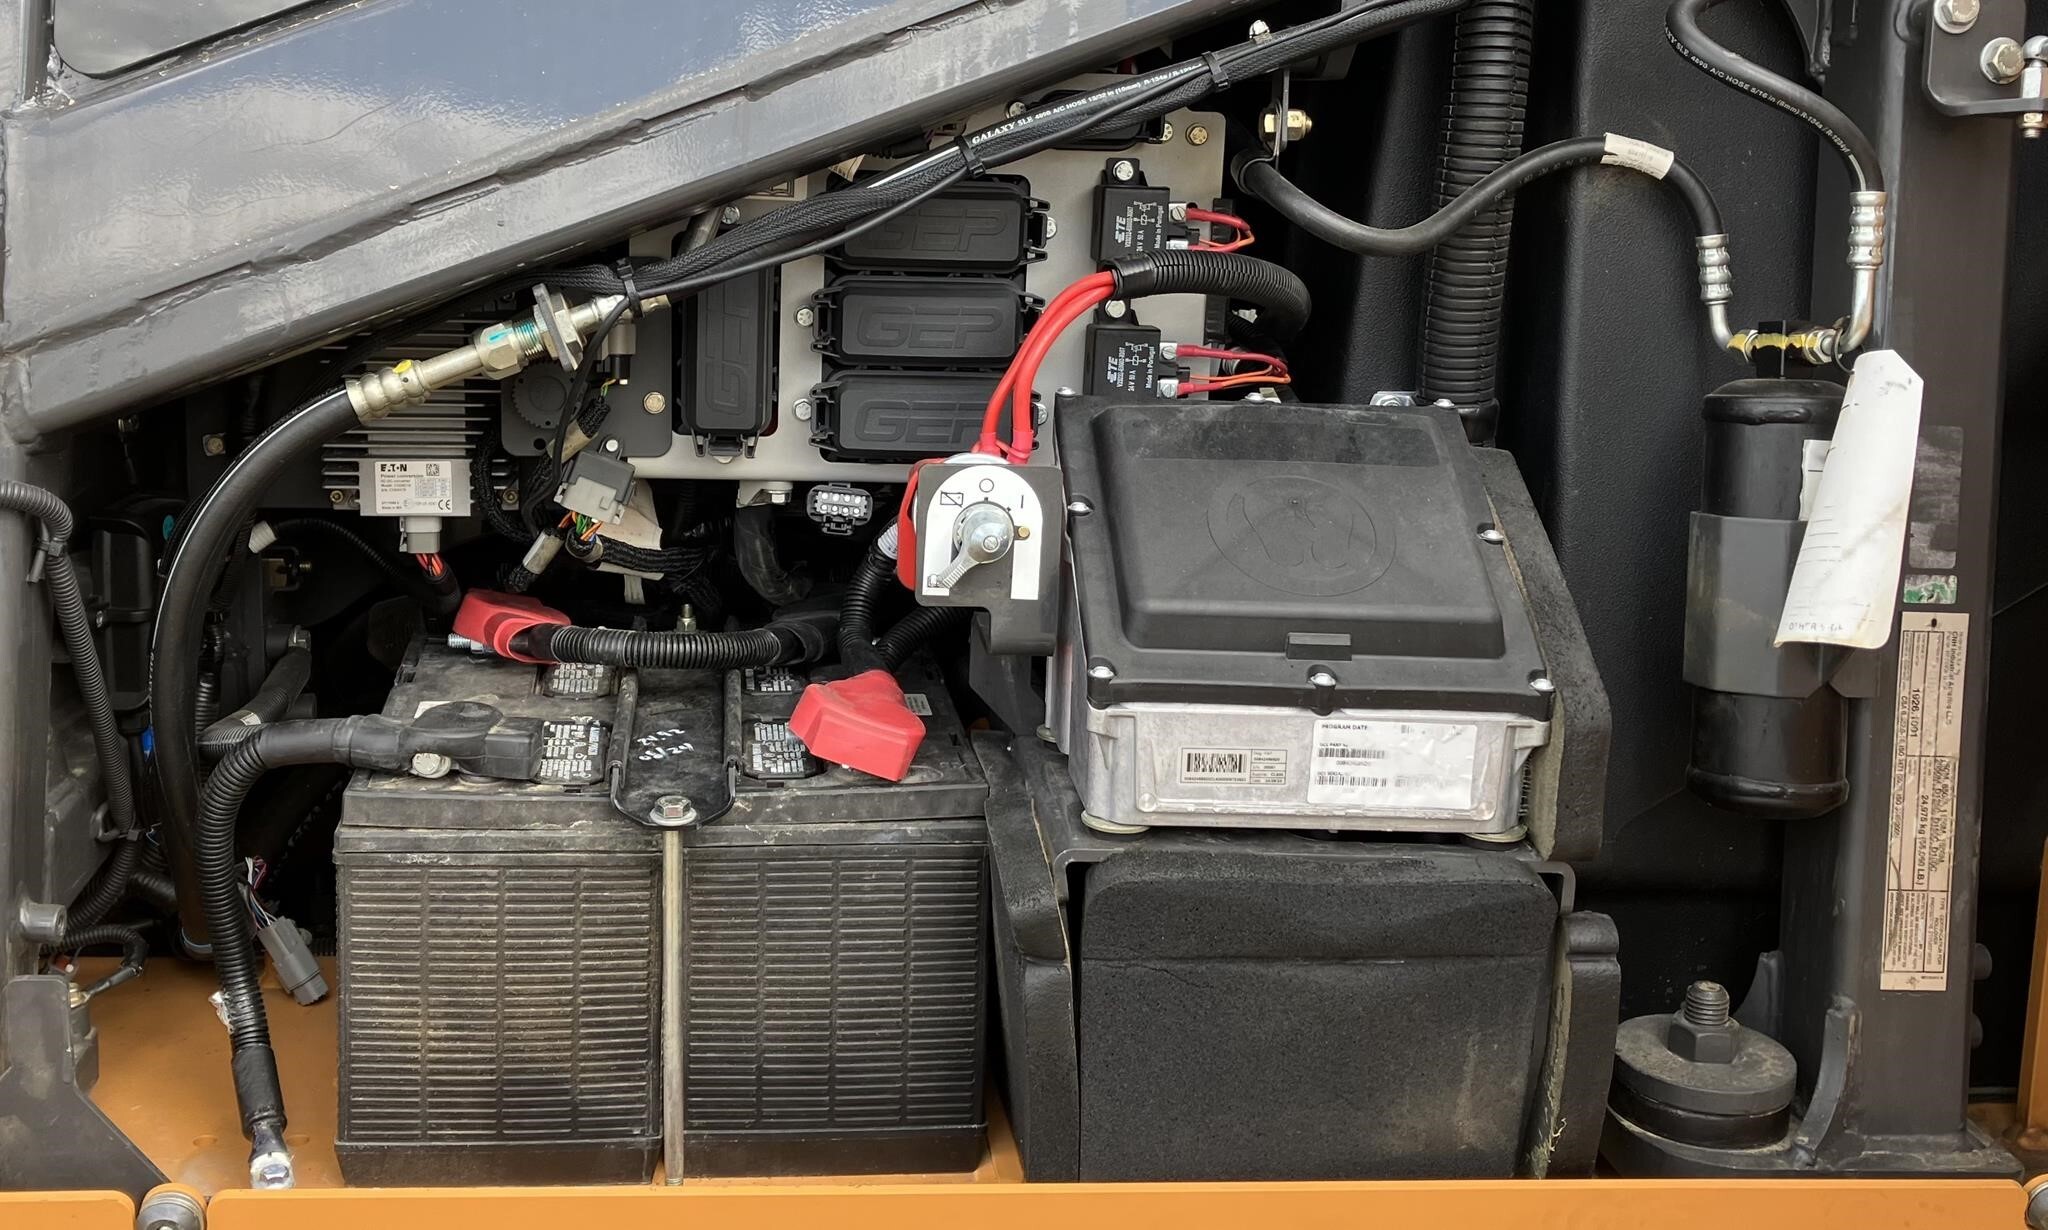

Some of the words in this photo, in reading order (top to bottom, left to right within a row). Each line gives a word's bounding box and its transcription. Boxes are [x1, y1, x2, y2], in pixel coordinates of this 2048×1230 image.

[1675, 42, 1689, 57] SLE
[1709, 67, 1725, 78] A/C
[1725, 75, 1751, 91] HOSE
[1776, 99, 1800, 115] (8mm)
[971, 121, 1015, 145] GALAXY
[1017, 115, 1034, 127] SLE
[1052, 105, 1066, 114] A/C
[1066, 98, 1088, 110] HOSE
[1115, 82, 1141, 95] (10mm)
[1156, 205, 1164, 228] Portugal
[1153, 234, 1161, 249] Made
[856, 305, 1003, 349] GEP
[1147, 346, 1155, 368] Portugal
[1145, 374, 1153, 389] Made
[380, 463, 407, 472] EATON
[1909, 688, 1921, 738] 1926.1001
[1920, 794, 1929, 822] 24,975
[1918, 823, 1927, 834] kg
[1915, 868, 1925, 886] LB.)
